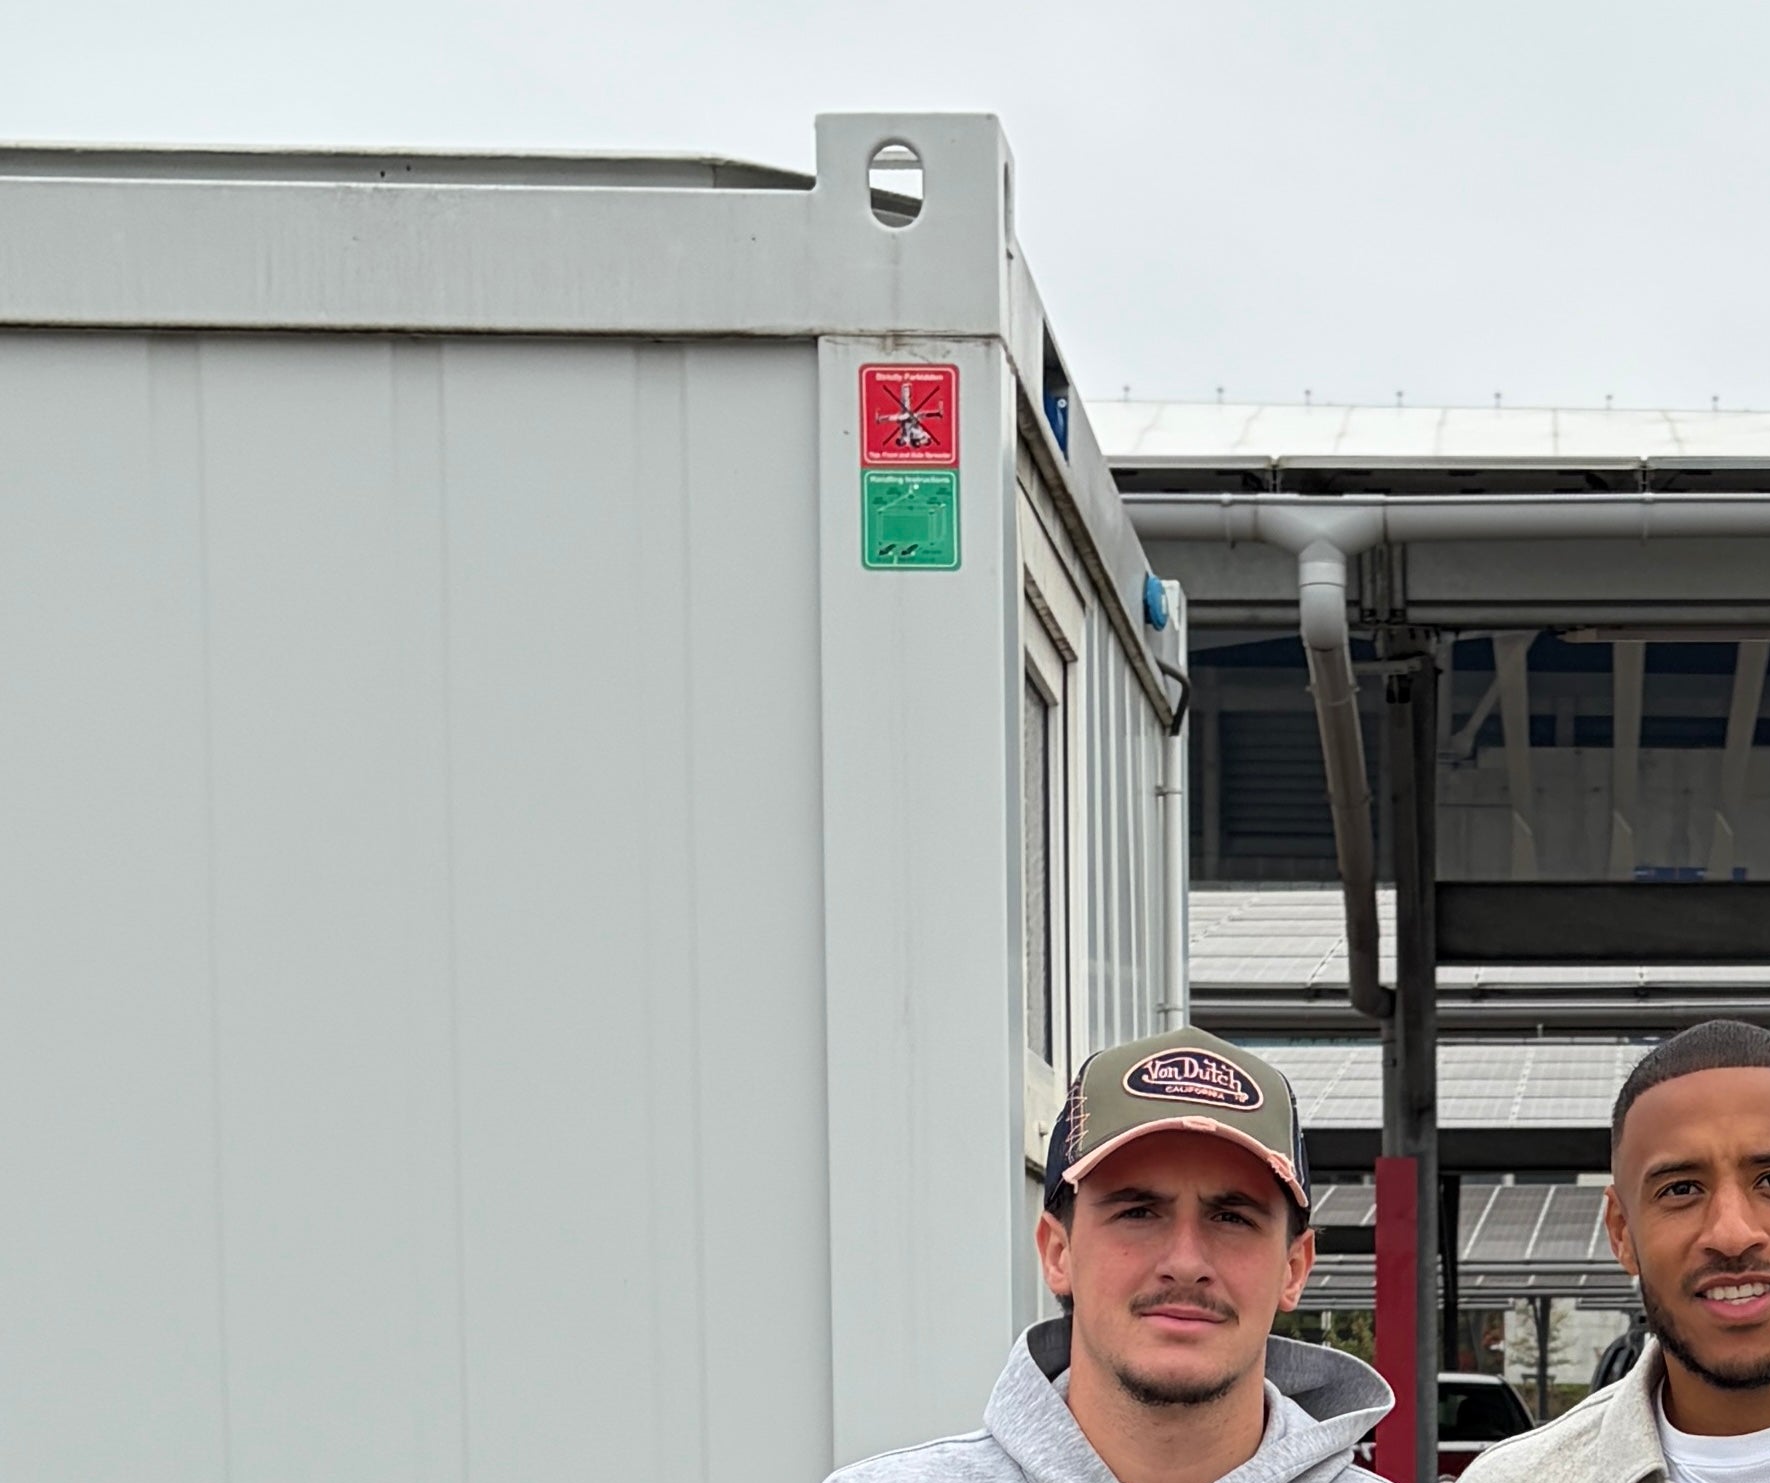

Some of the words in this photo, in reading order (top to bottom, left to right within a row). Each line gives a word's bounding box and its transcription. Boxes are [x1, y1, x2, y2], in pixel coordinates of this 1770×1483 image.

[1142, 1058, 1184, 1081] Von
[1183, 1056, 1242, 1095] Dutch
[1165, 1085, 1225, 1100] CALIFORNIA
